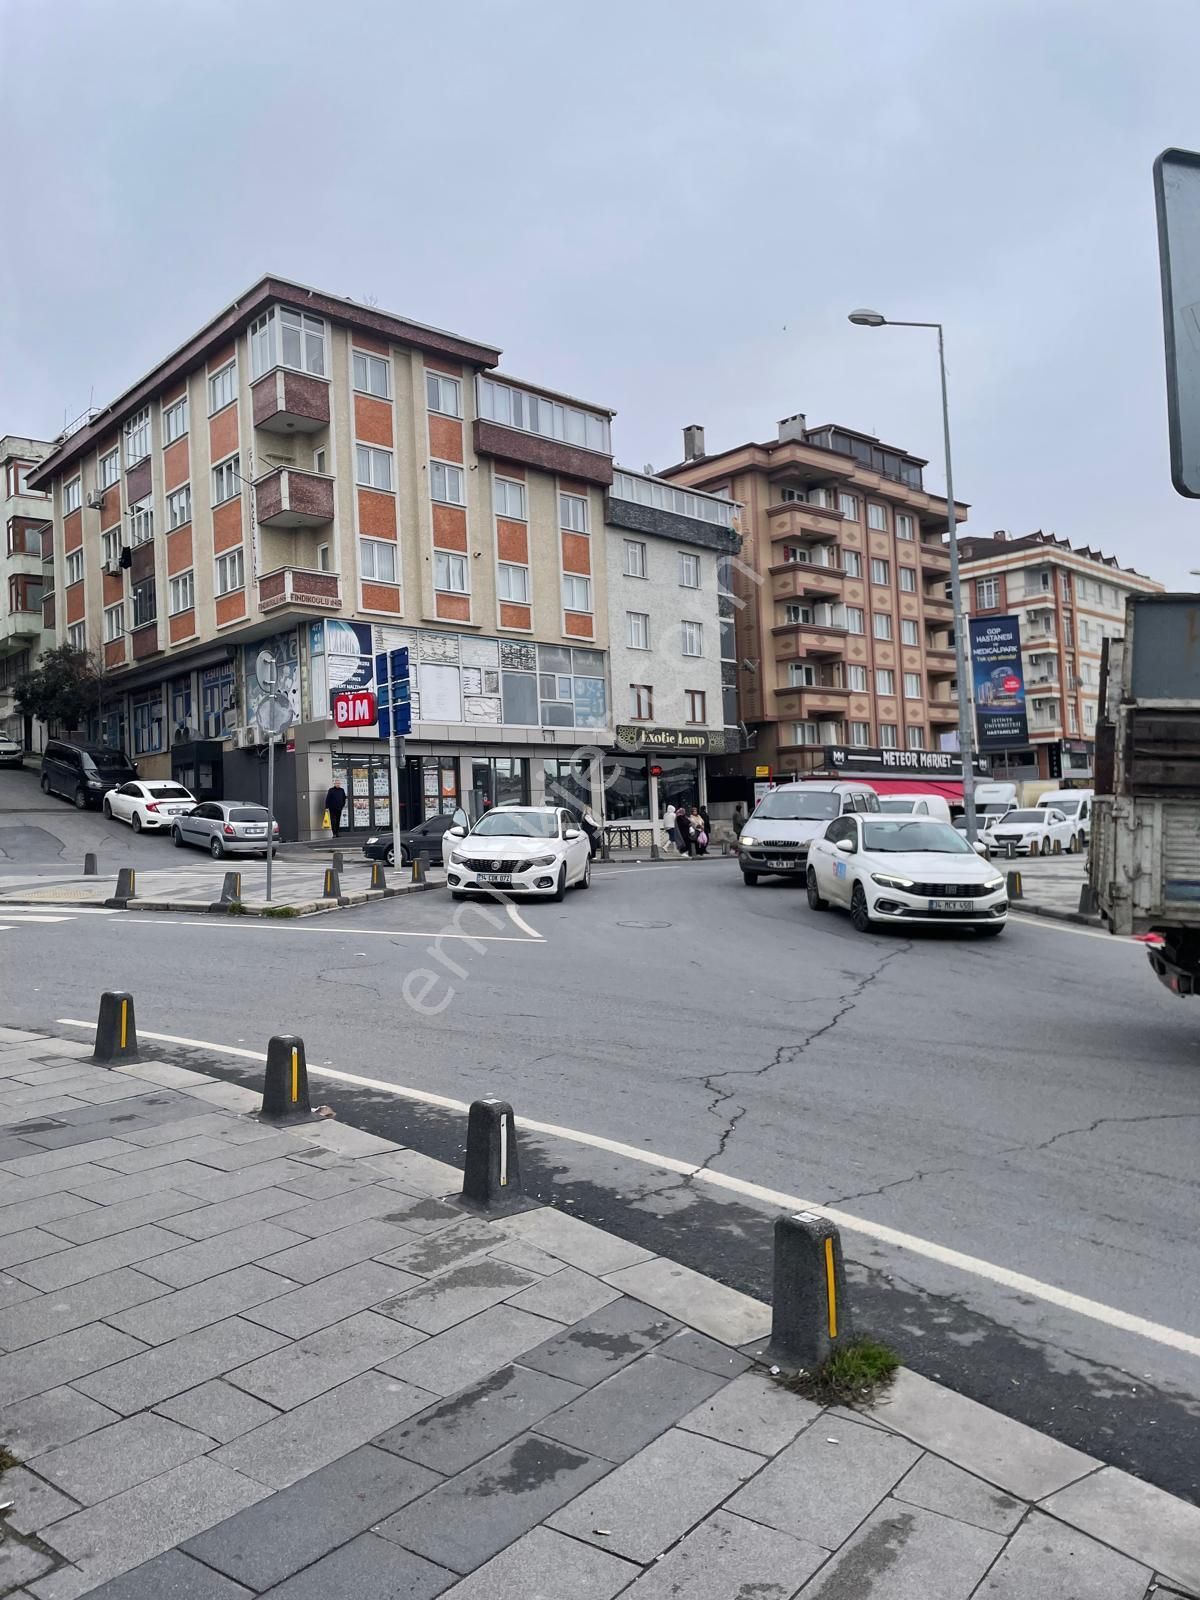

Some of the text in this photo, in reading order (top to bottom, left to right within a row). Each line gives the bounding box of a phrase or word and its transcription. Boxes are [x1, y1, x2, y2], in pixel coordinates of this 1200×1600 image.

[641, 730, 705, 747] Exotic Lamp
[882, 751, 918, 767] METEOR
[919, 752, 952, 769] MARKET
